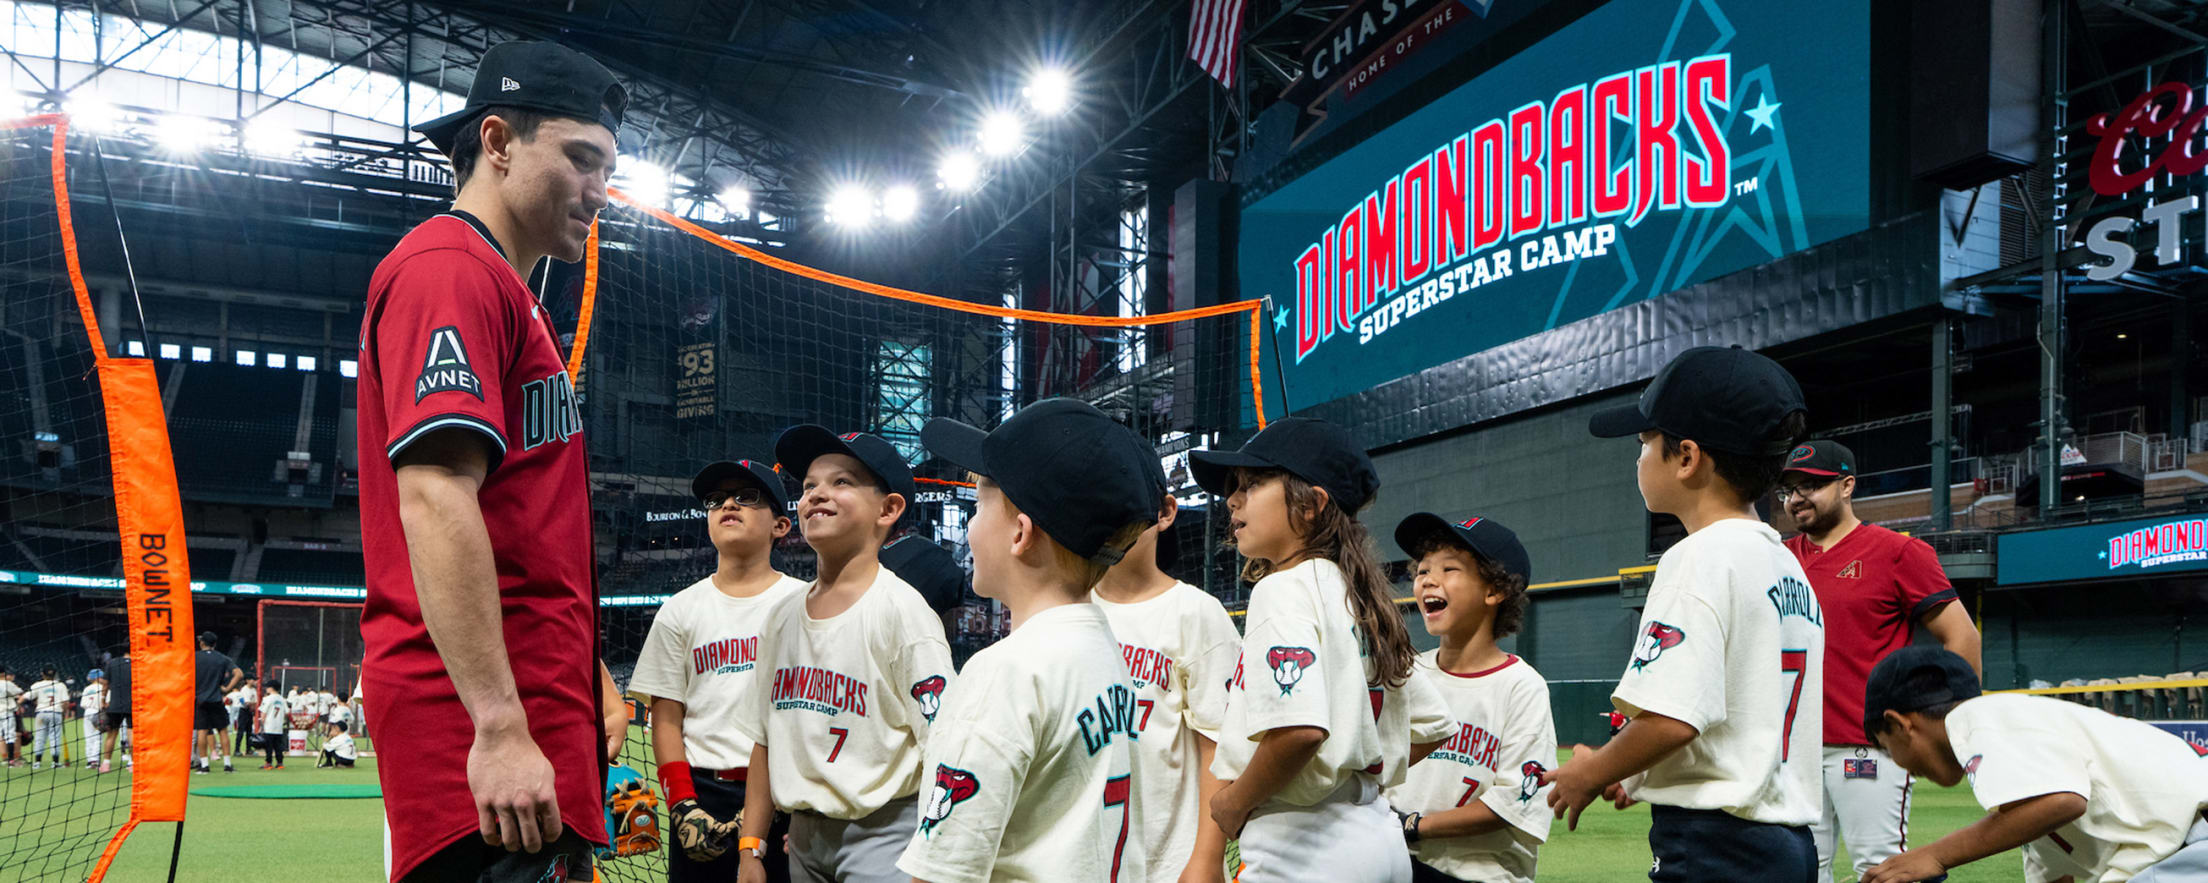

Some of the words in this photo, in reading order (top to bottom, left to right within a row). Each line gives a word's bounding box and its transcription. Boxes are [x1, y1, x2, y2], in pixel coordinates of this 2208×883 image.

[1312, 0, 1419, 79] CHAS
[1348, 54, 1386, 92] HOME
[1396, 35, 1414, 55] OF
[1423, 7, 1453, 36] THE
[1294, 53, 1731, 365] DIAMONDBACKS
[2086, 195, 2208, 281] ST
[1359, 247, 1513, 345] SUPERSTAR
[1521, 223, 1616, 271] CAMP
[417, 369, 481, 398] AVNET
[2109, 518, 2208, 570] DIAMOND
[2141, 551, 2208, 568] SUPERSTAR
[140, 534, 173, 642] BOWNET
[1119, 643, 1173, 691] BACKS
[816, 703, 839, 717] CAMP
[1137, 699, 1155, 732] 7
[1781, 649, 1807, 763] 7
[827, 727, 848, 763] 7
[1455, 776, 1481, 808] 7
[1103, 773, 1131, 883] 7
